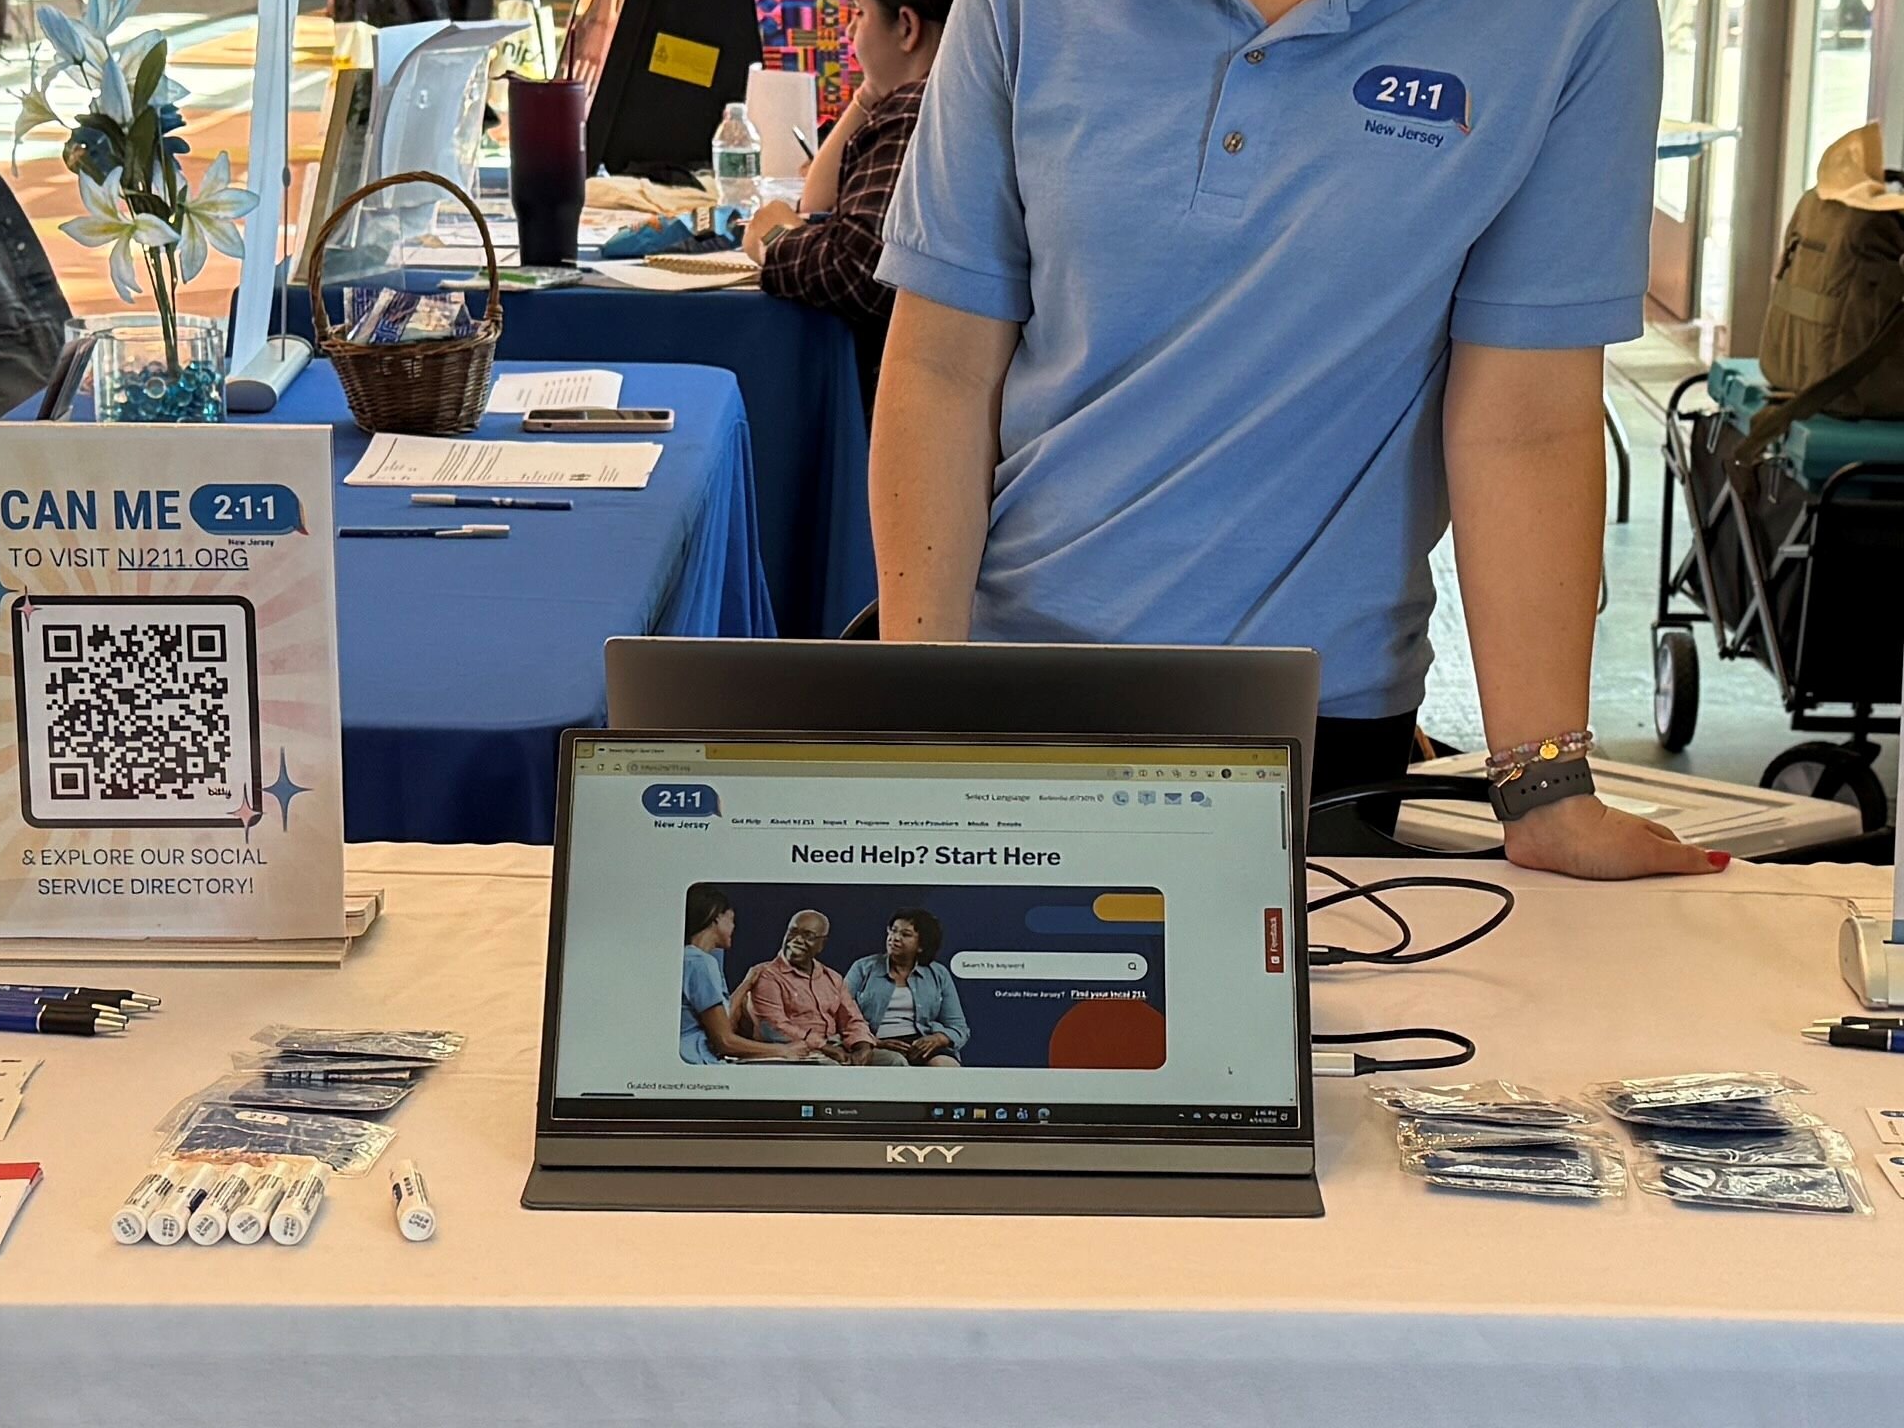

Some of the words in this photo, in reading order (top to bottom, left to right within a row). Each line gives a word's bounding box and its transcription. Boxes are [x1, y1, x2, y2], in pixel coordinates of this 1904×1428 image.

[1364, 119, 1395, 136] New
[1397, 126, 1445, 148] Jersey
[113, 490, 182, 530] ME
[228, 538, 245, 546] New
[248, 538, 274, 548] Jersey
[8, 548, 42, 567] TO
[49, 548, 110, 567] VISIT
[118, 547, 249, 570] NJ211.ORG
[654, 820, 675, 829] New
[676, 820, 711, 831] Jersey
[22, 848, 36, 865] &
[41, 848, 134, 864] EXPLORE
[140, 848, 185, 865] OUR
[191, 848, 268, 865] SOCIAL
[791, 844, 854, 864] Need
[860, 845, 929, 870] Help?
[935, 846, 997, 866] Start
[1004, 847, 1062, 867] Here
[38, 878, 125, 895] SERVICE
[130, 878, 254, 895] DIRECTORY!
[886, 1144, 963, 1163] KYY
